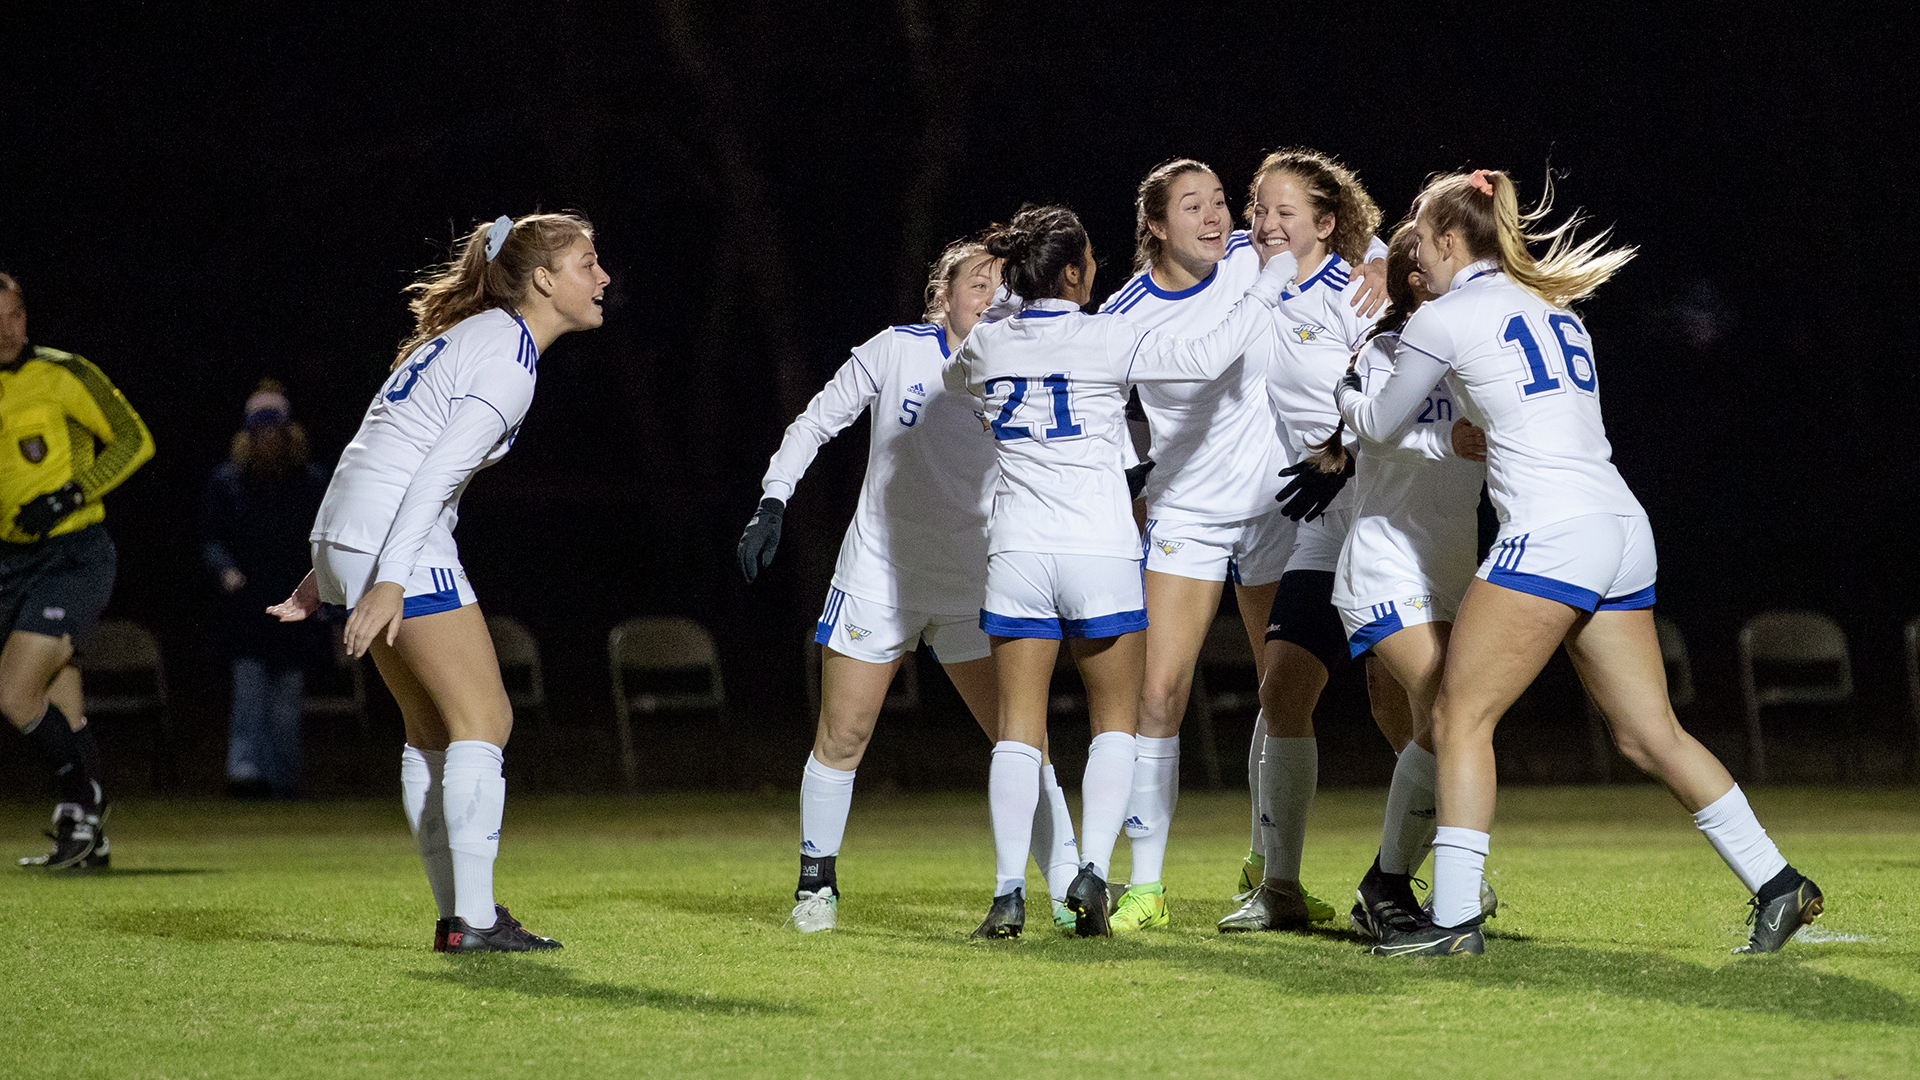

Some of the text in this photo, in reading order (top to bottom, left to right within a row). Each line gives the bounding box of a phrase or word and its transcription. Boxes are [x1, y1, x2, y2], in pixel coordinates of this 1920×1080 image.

[1499, 310, 1598, 400] 16
[899, 398, 923, 428] 5
[983, 371, 1085, 442] 21
